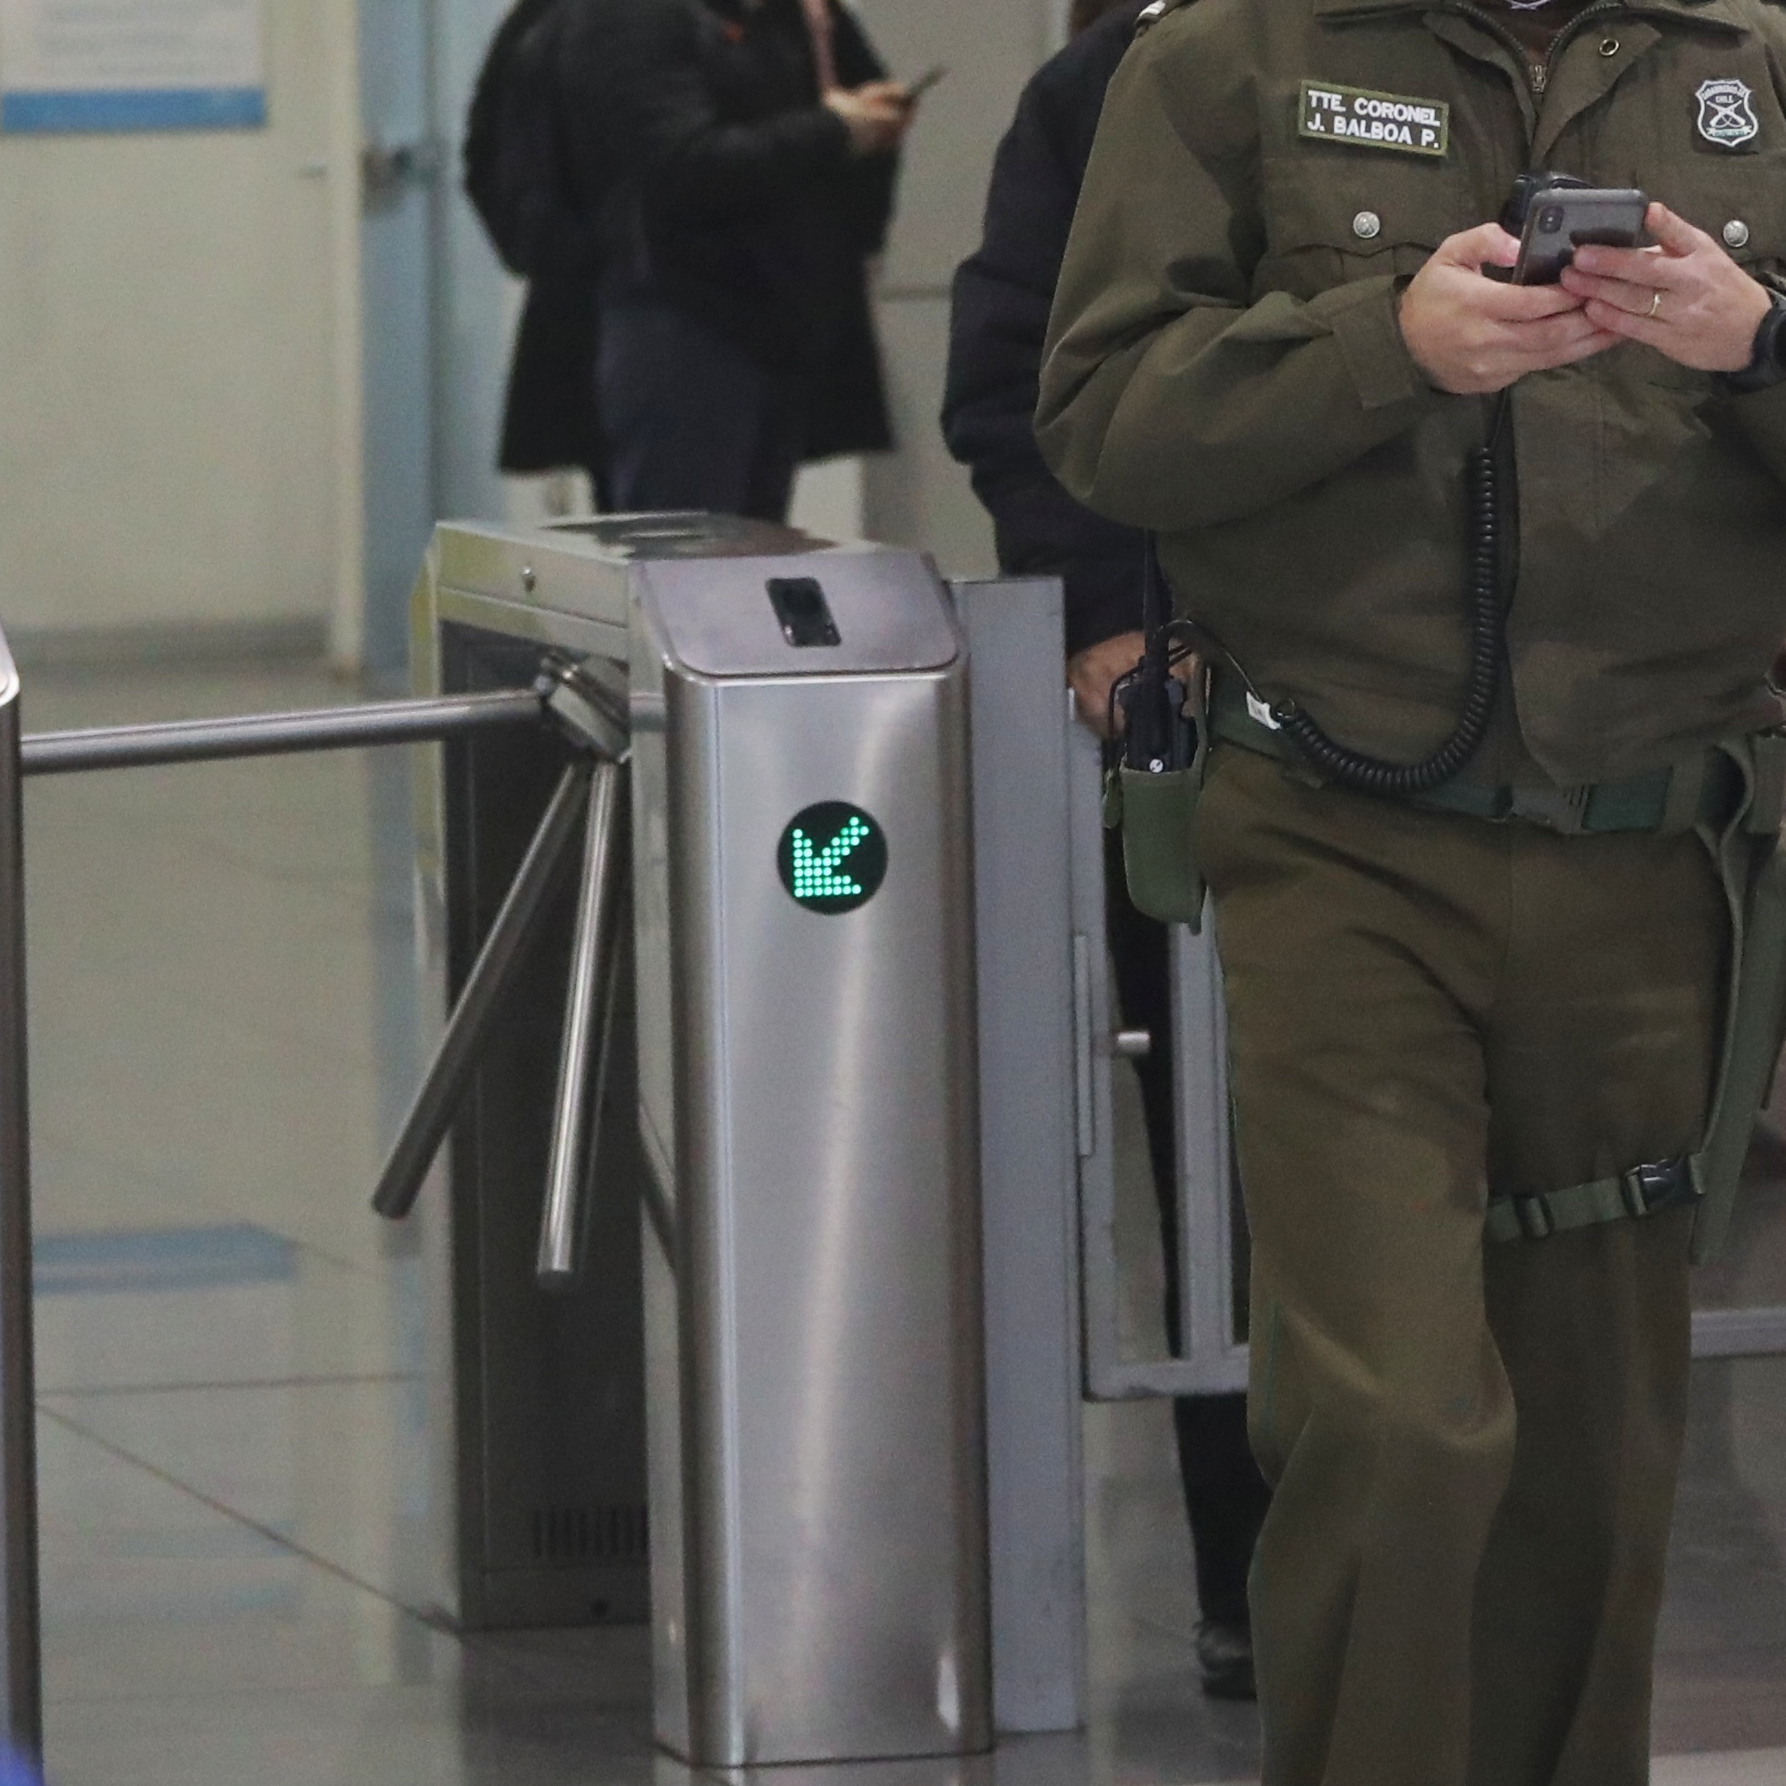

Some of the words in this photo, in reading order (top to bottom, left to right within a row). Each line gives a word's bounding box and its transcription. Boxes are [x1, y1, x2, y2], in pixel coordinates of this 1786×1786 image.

[1353, 97, 1441, 127] CORONEL
[1307, 113, 1326, 131] J.
[1333, 115, 1413, 145] BALBOA
[1421, 128, 1440, 149] P.
